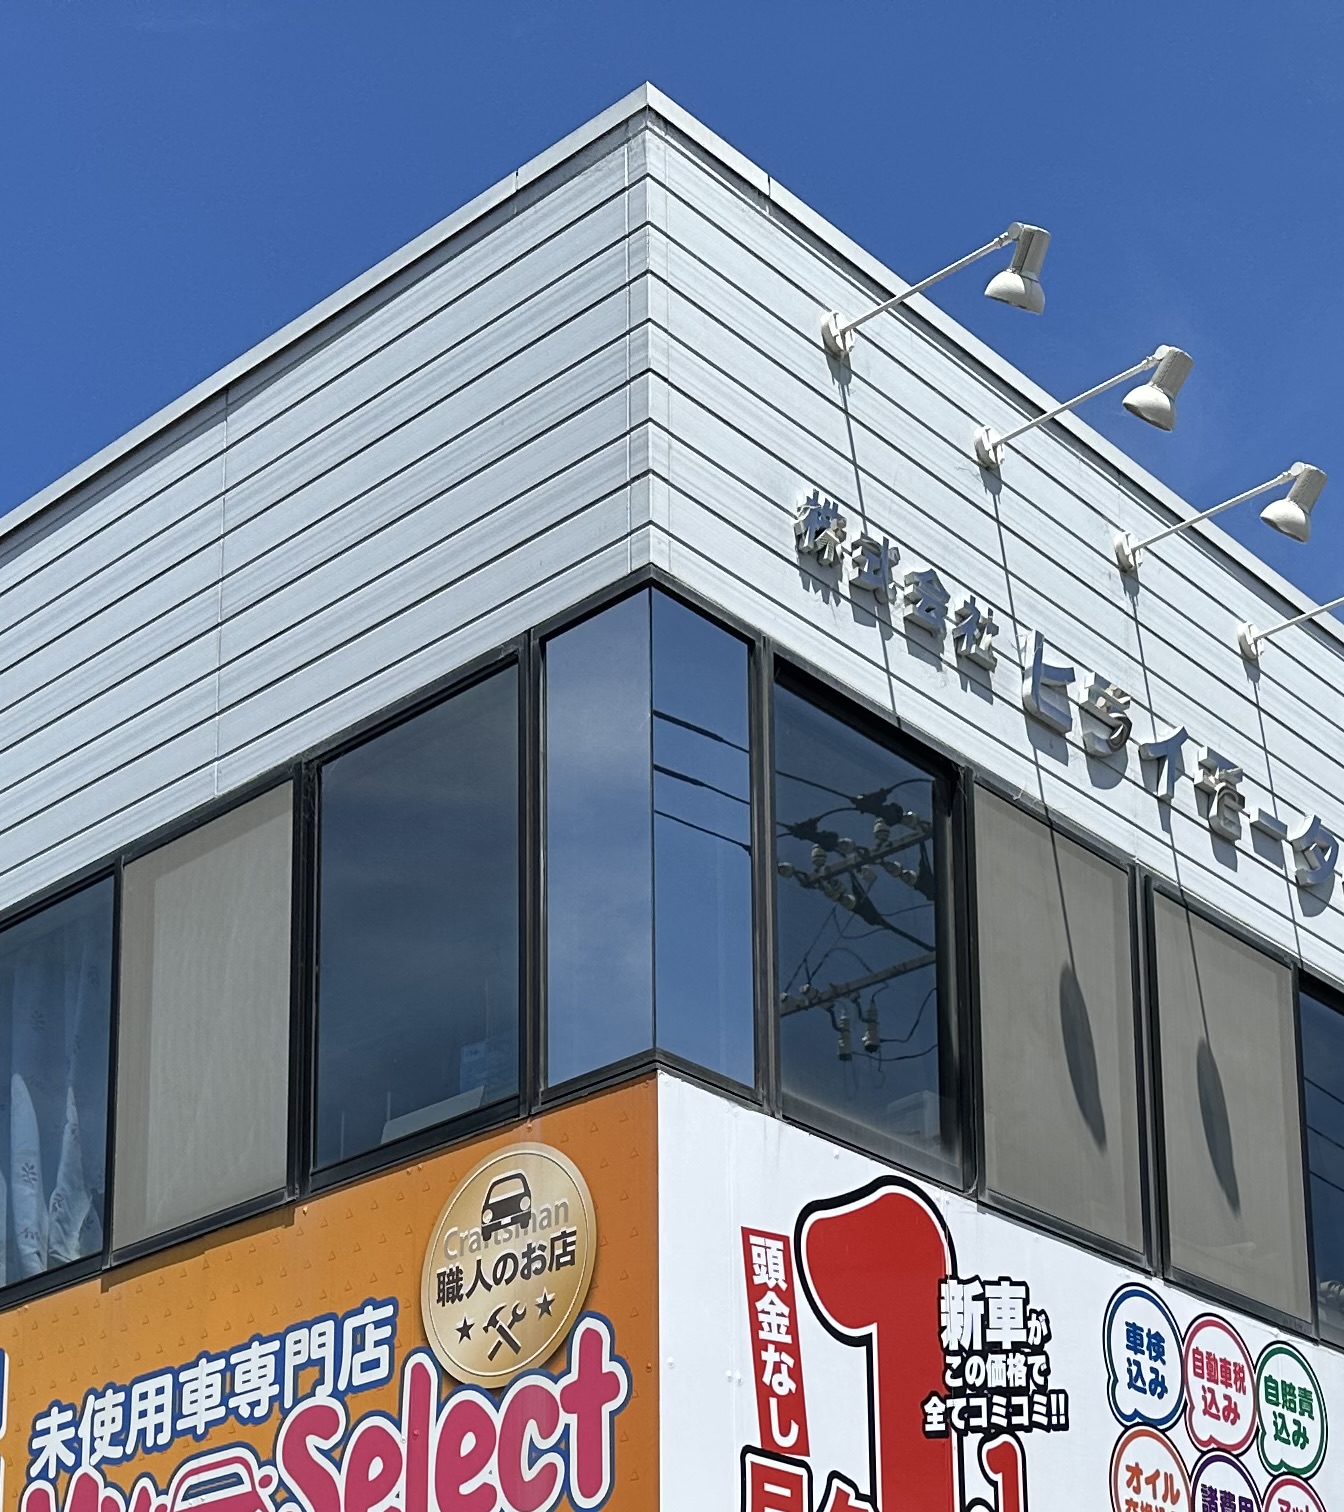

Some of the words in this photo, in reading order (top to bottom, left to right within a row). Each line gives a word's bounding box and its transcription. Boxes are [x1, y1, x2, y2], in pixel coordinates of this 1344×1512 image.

[793, 487, 998, 672] 株式会社
[443, 1199, 569, 1261] Cratsman
[436, 1229, 577, 1307] 職人のお店
[940, 1279, 1049, 1351] 新車が
[750, 1236, 800, 1449] 頭金なし
[1125, 1320, 1166, 1365] 車検
[30, 1301, 395, 1480] 未使用車専門店
[944, 1352, 1049, 1390] この価格で
[1126, 1357, 1168, 1400] 込み
[1192, 1347, 1246, 1394] 自動車税
[1201, 1385, 1240, 1426] 込み
[1263, 1375, 1314, 1420] 自賠責
[1272, 1411, 1309, 1450] 込み
[1125, 1462, 1180, 1505] オイル
